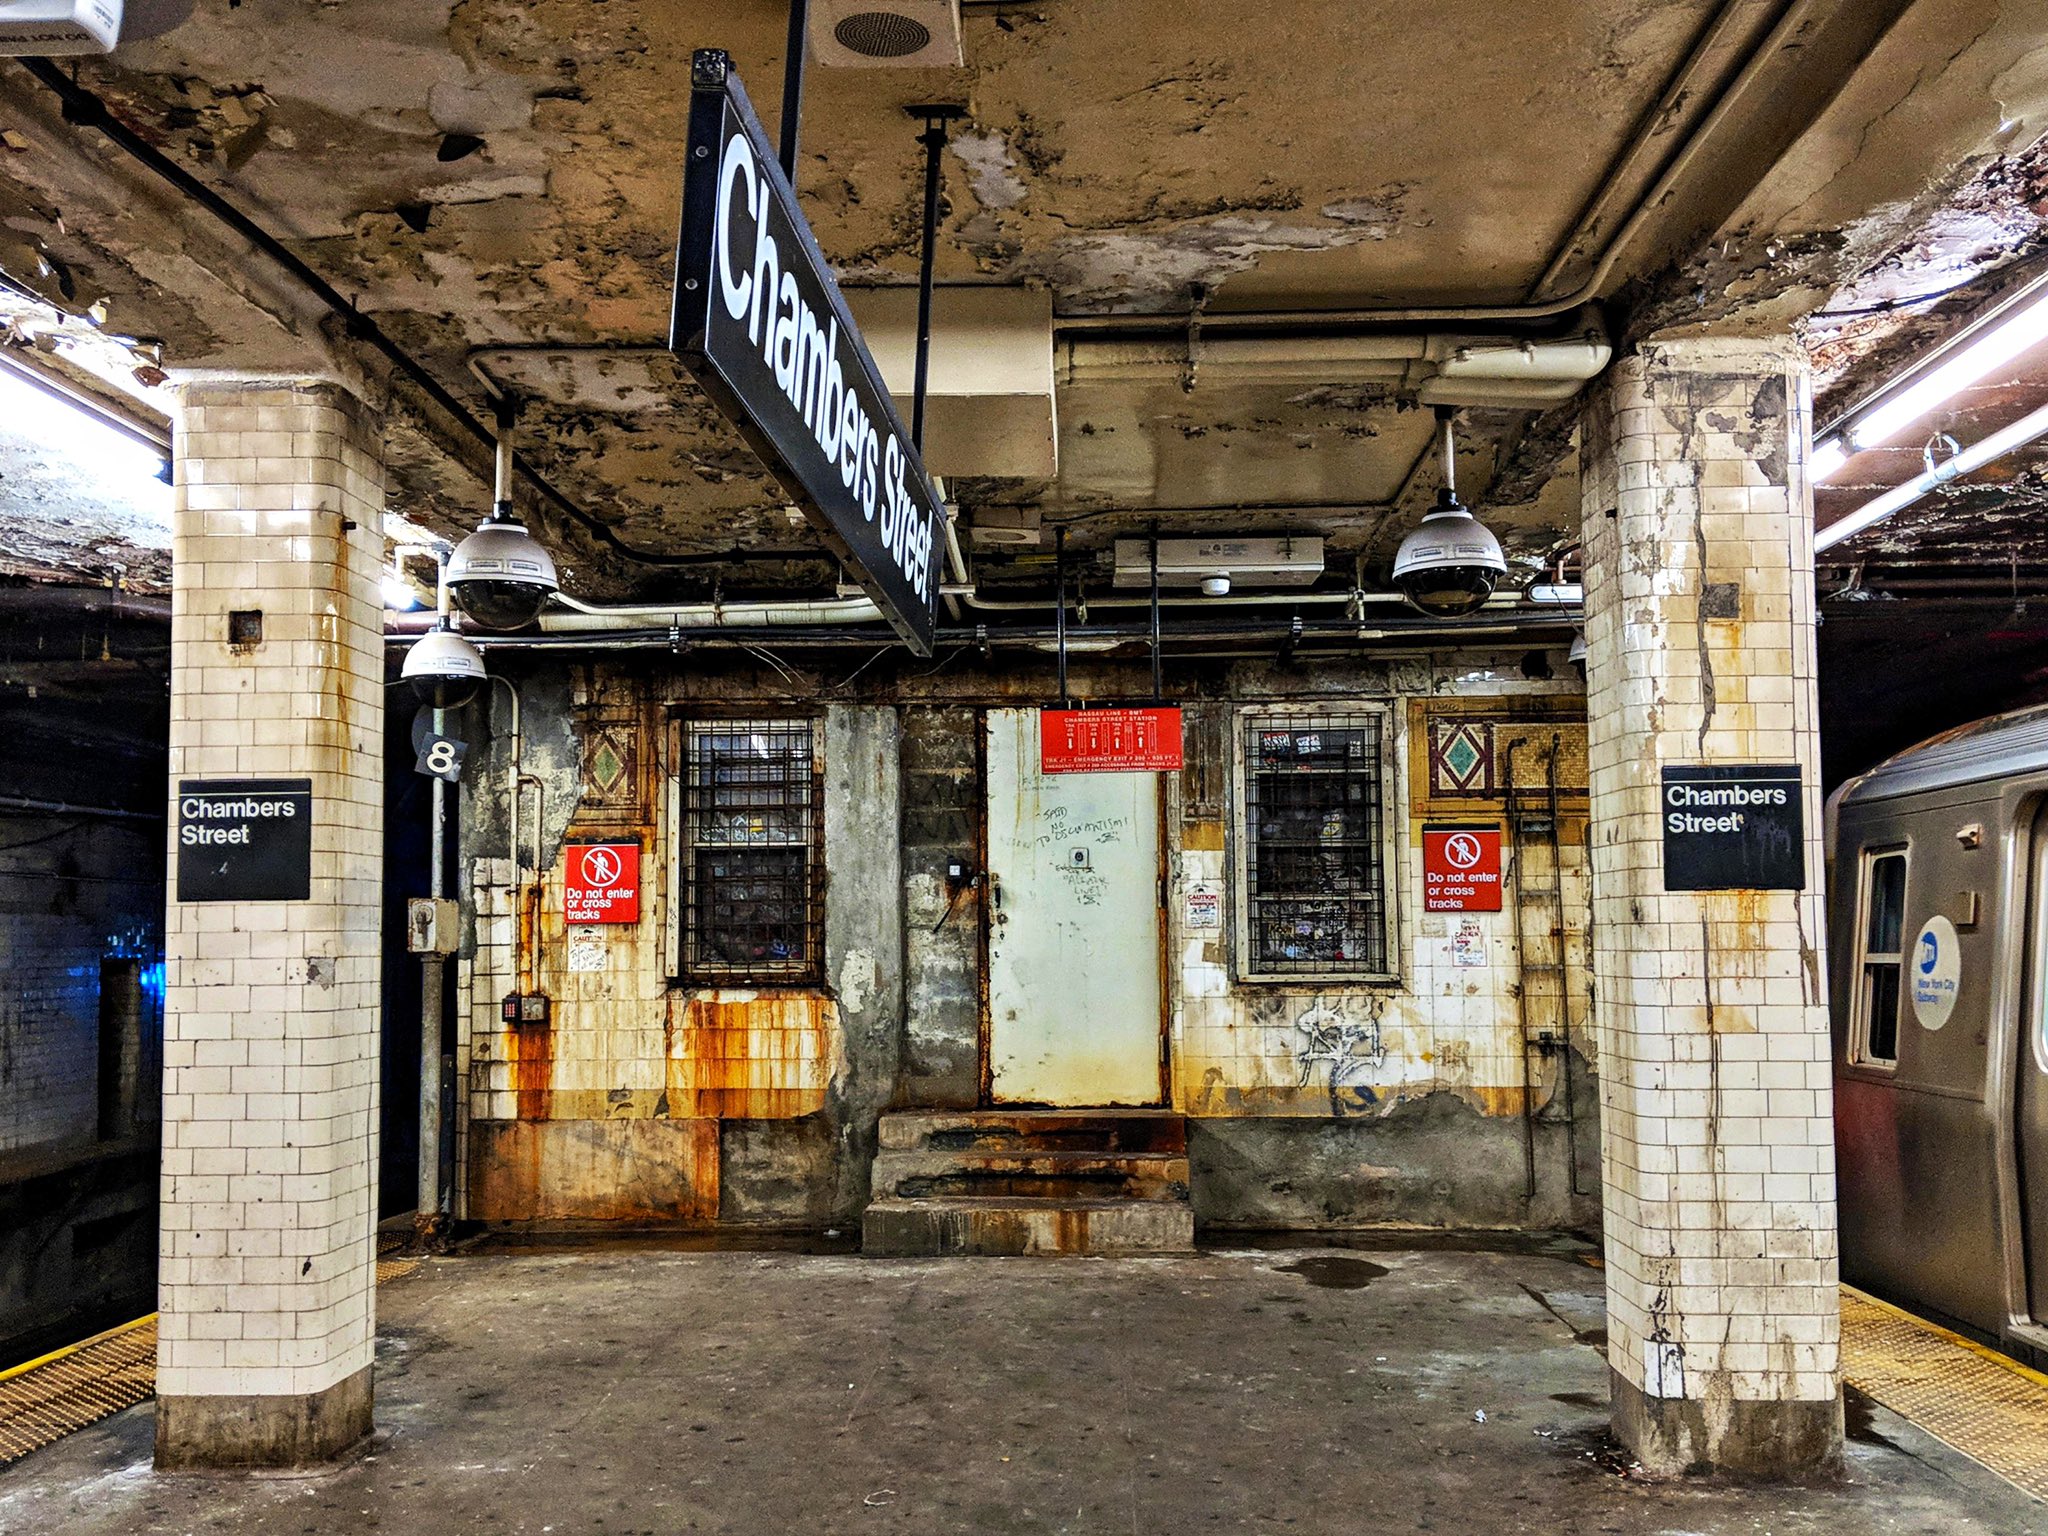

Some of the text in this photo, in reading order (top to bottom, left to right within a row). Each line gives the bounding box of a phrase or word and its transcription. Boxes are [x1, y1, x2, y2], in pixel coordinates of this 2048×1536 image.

[718, 133, 932, 604] Chambers Street
[426, 740, 455, 774] 8
[1667, 785, 1787, 806] Chambers
[181, 798, 296, 819] Chambers
[1668, 812, 1741, 834] Street
[181, 824, 250, 845] Street
[1427, 872, 1498, 883] Do not enter
[567, 887, 635, 899] Do not enter
[1428, 886, 1476, 896] or cross
[567, 898, 612, 909] or cross
[1428, 898, 1464, 909] tracks
[567, 909, 601, 920] tracks
